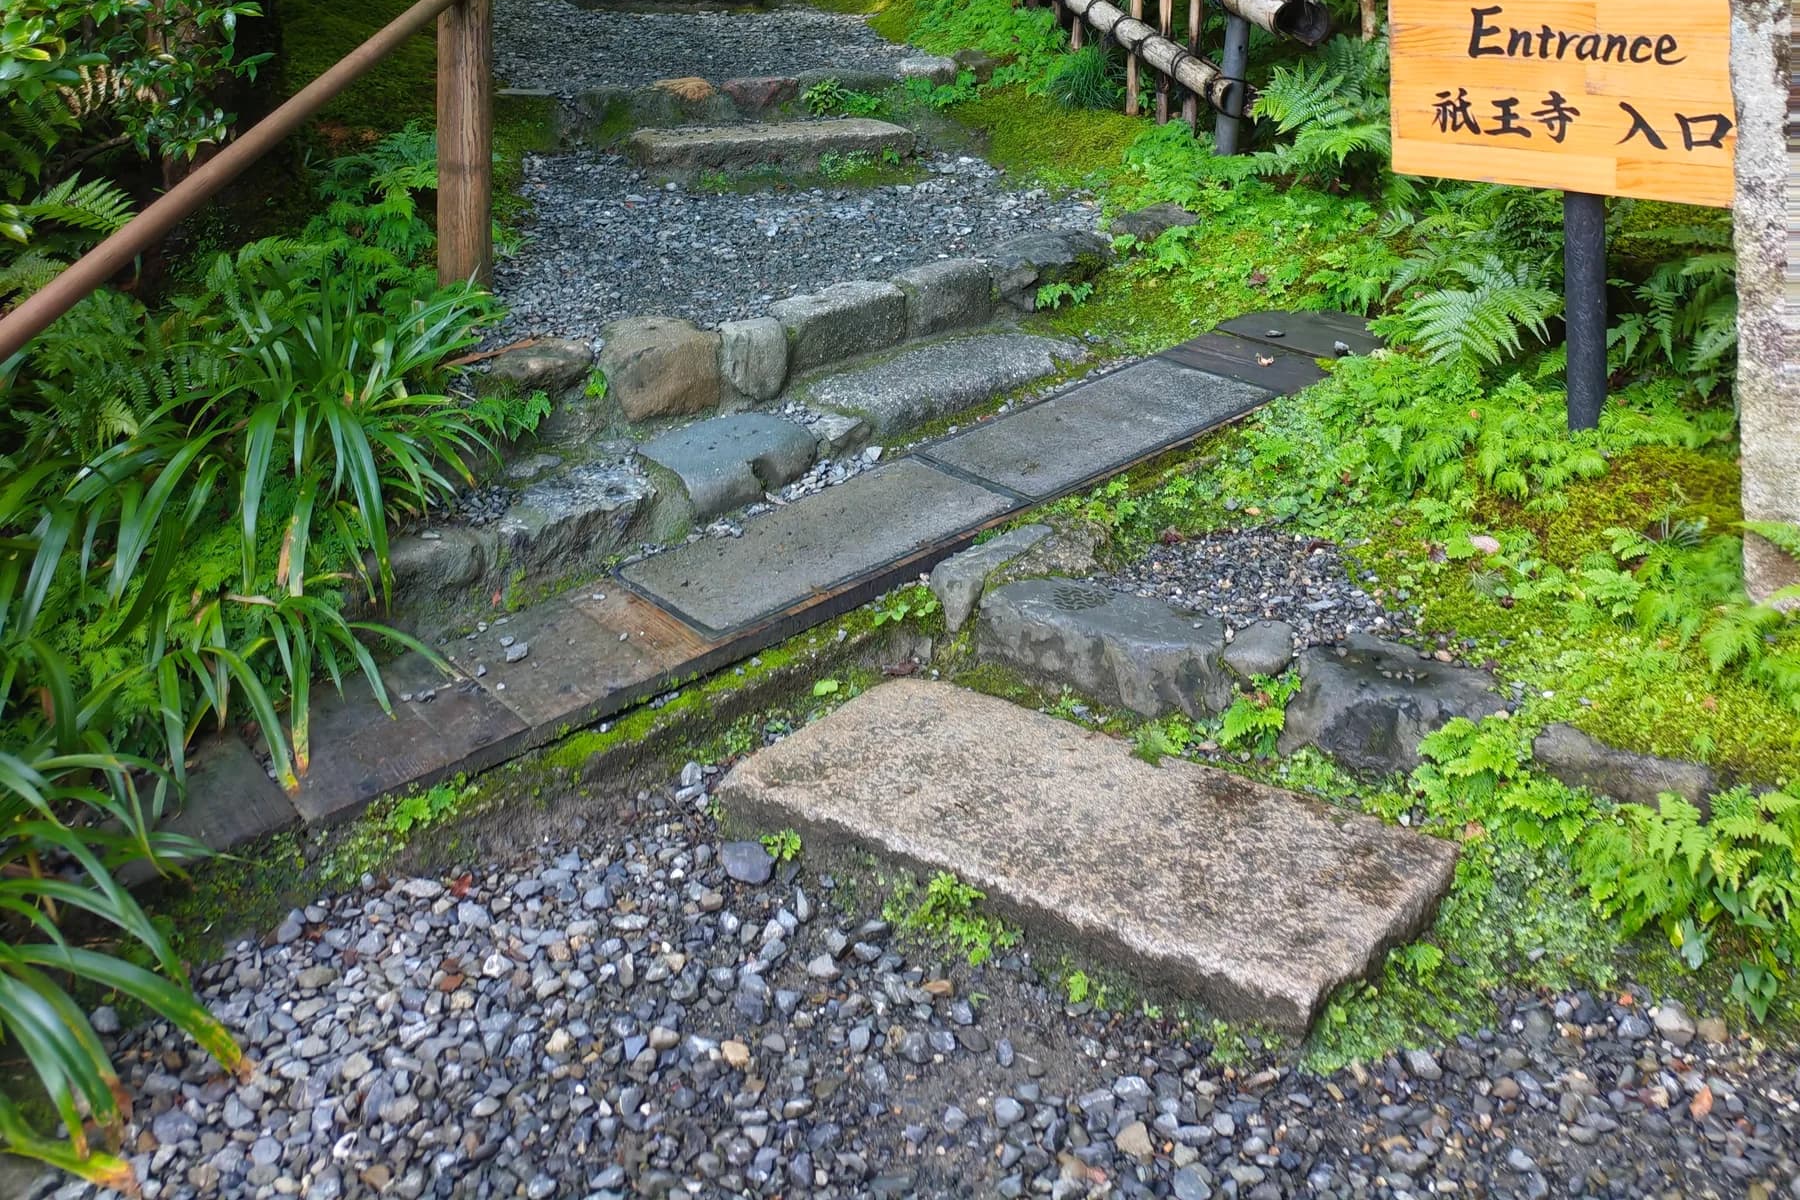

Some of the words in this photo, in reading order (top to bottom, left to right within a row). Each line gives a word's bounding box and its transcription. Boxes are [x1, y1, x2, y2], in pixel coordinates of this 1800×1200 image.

[1467, 6, 1687, 65] Entrance
[1431, 87, 1580, 144] 祇王寺
[1615, 101, 1734, 151] 入口
